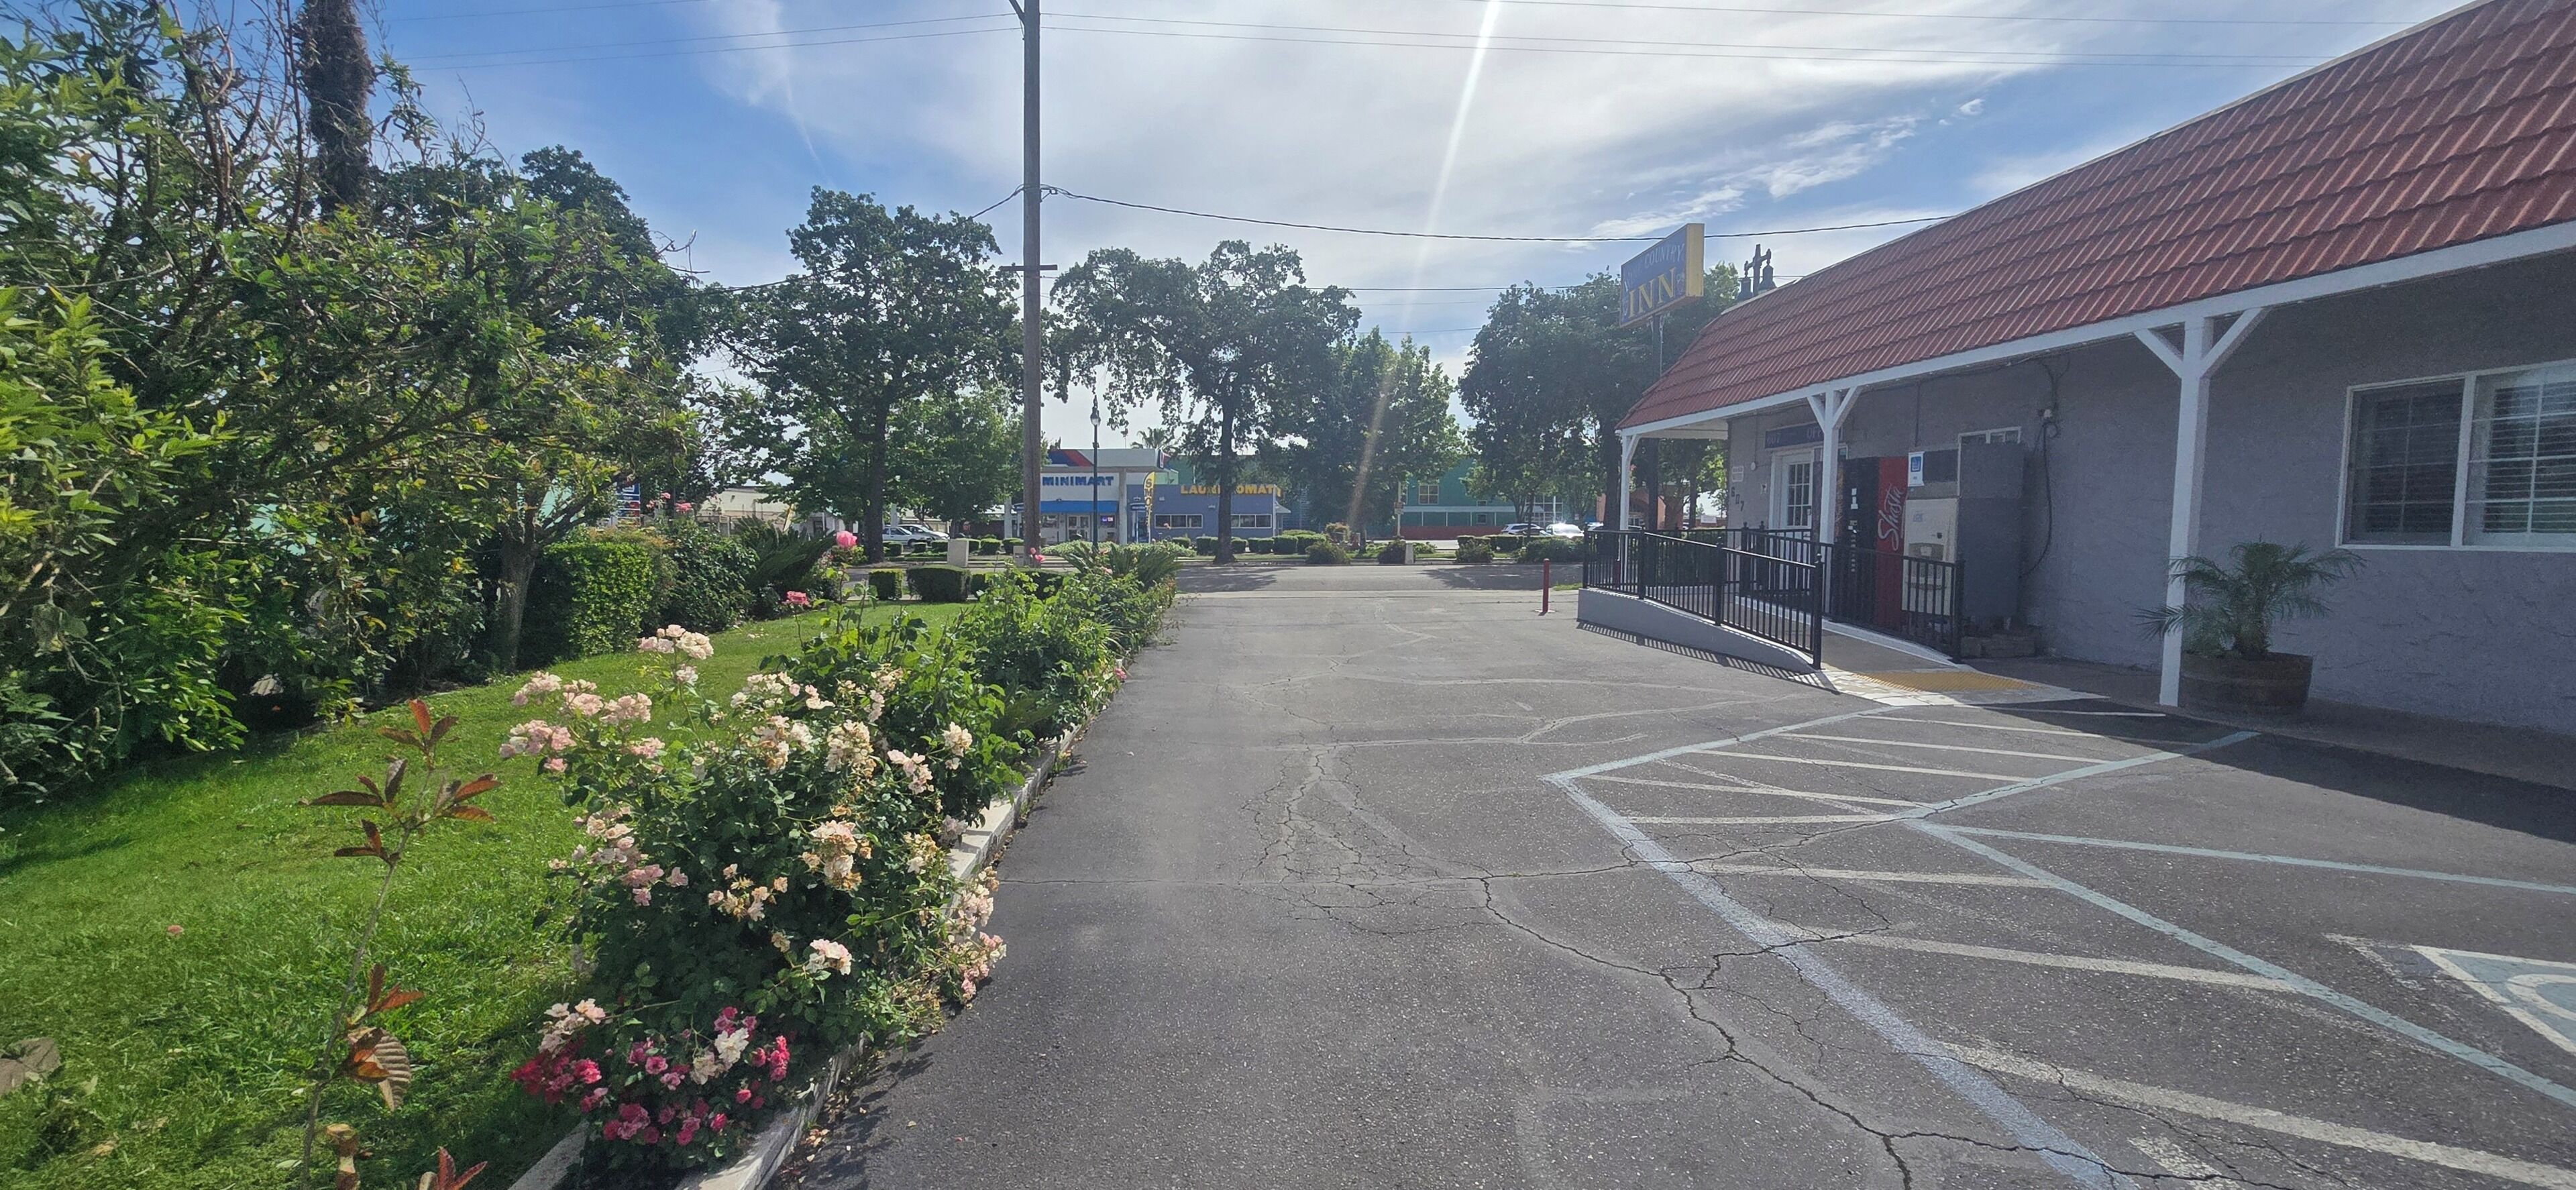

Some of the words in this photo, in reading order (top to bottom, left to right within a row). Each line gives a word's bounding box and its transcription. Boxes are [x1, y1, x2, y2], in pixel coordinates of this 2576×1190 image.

[1629, 267, 1676, 318] INN
[1042, 476, 1114, 486] MINIMART
[1181, 484, 1274, 494] LAUNOMAT
[1731, 486, 1744, 511] 607
[1878, 484, 1904, 551] Shasta
